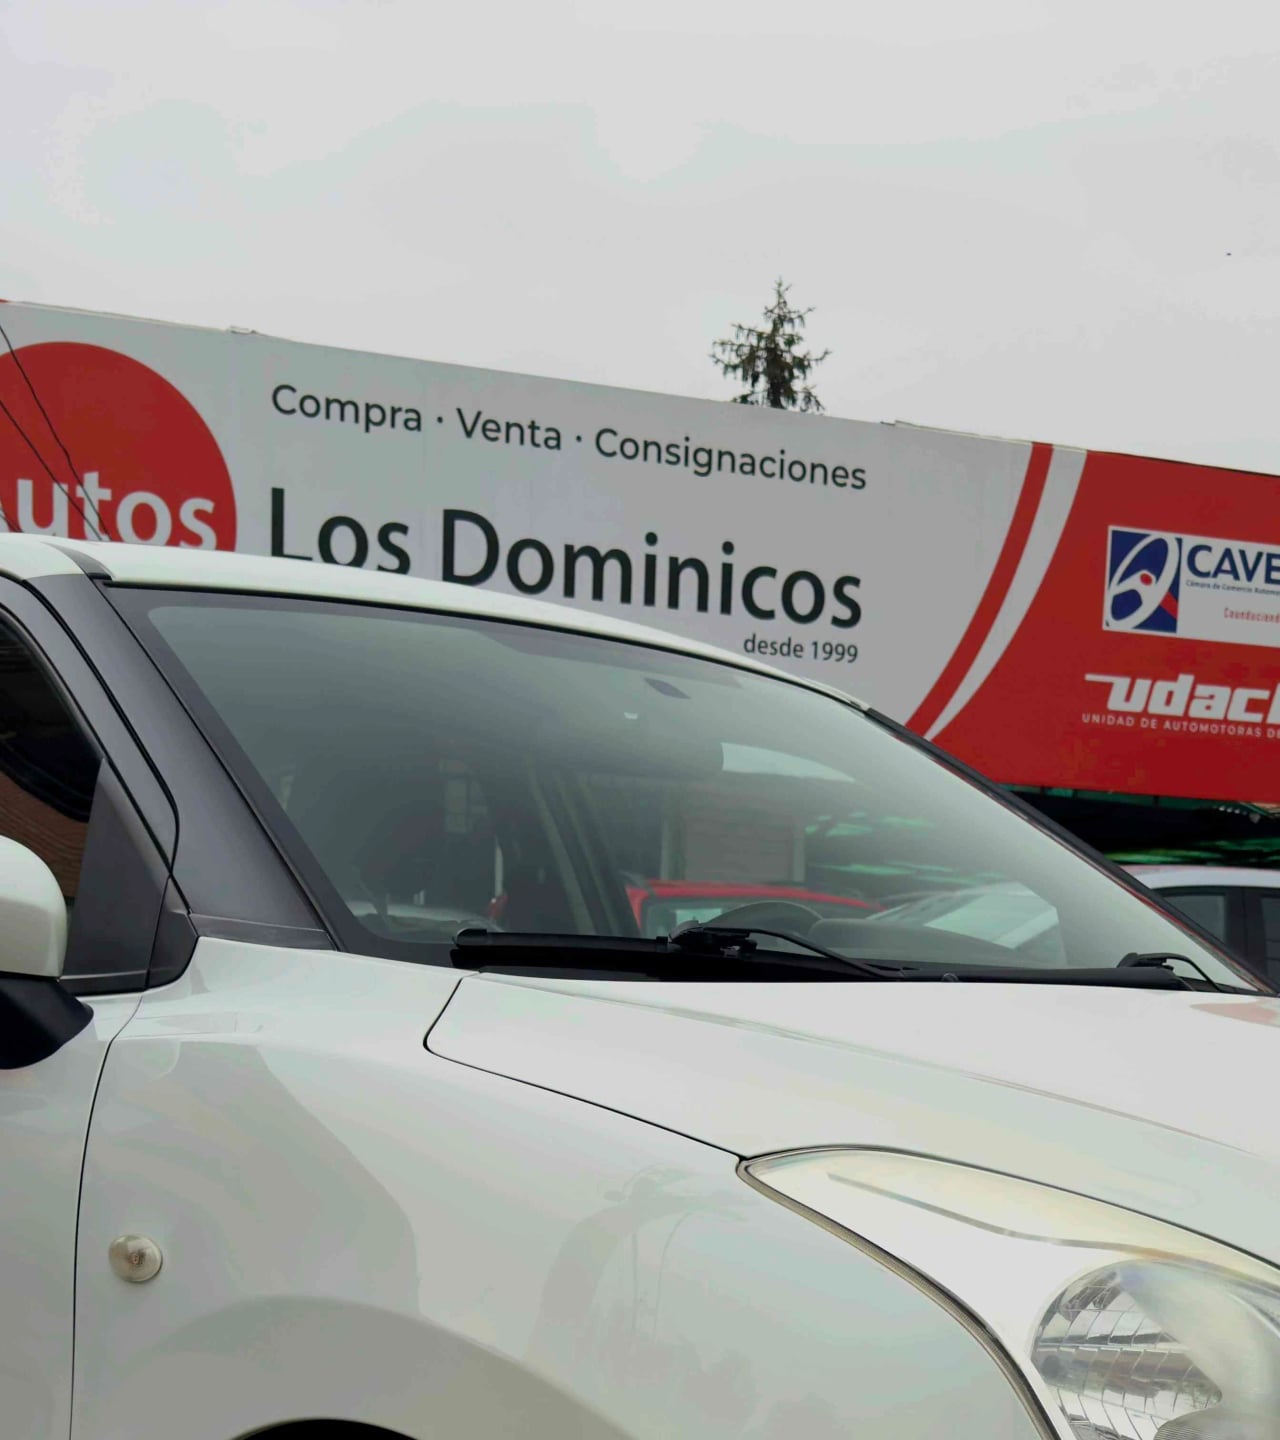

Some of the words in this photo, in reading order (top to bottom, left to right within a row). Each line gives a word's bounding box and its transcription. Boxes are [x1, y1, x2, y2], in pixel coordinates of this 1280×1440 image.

[271, 384, 422, 433] Compra
[456, 407, 562, 450] Venta
[595, 429, 867, 490] Consignaciones
[271, 487, 411, 575] Los
[441, 508, 863, 629] Dominicos
[743, 633, 804, 659] desde
[810, 640, 859, 664] 1999
[1081, 713, 1134, 727] UNIDAD
[1140, 717, 1157, 729] DE
[1163, 720, 1262, 737] AUTOMOTORAS
